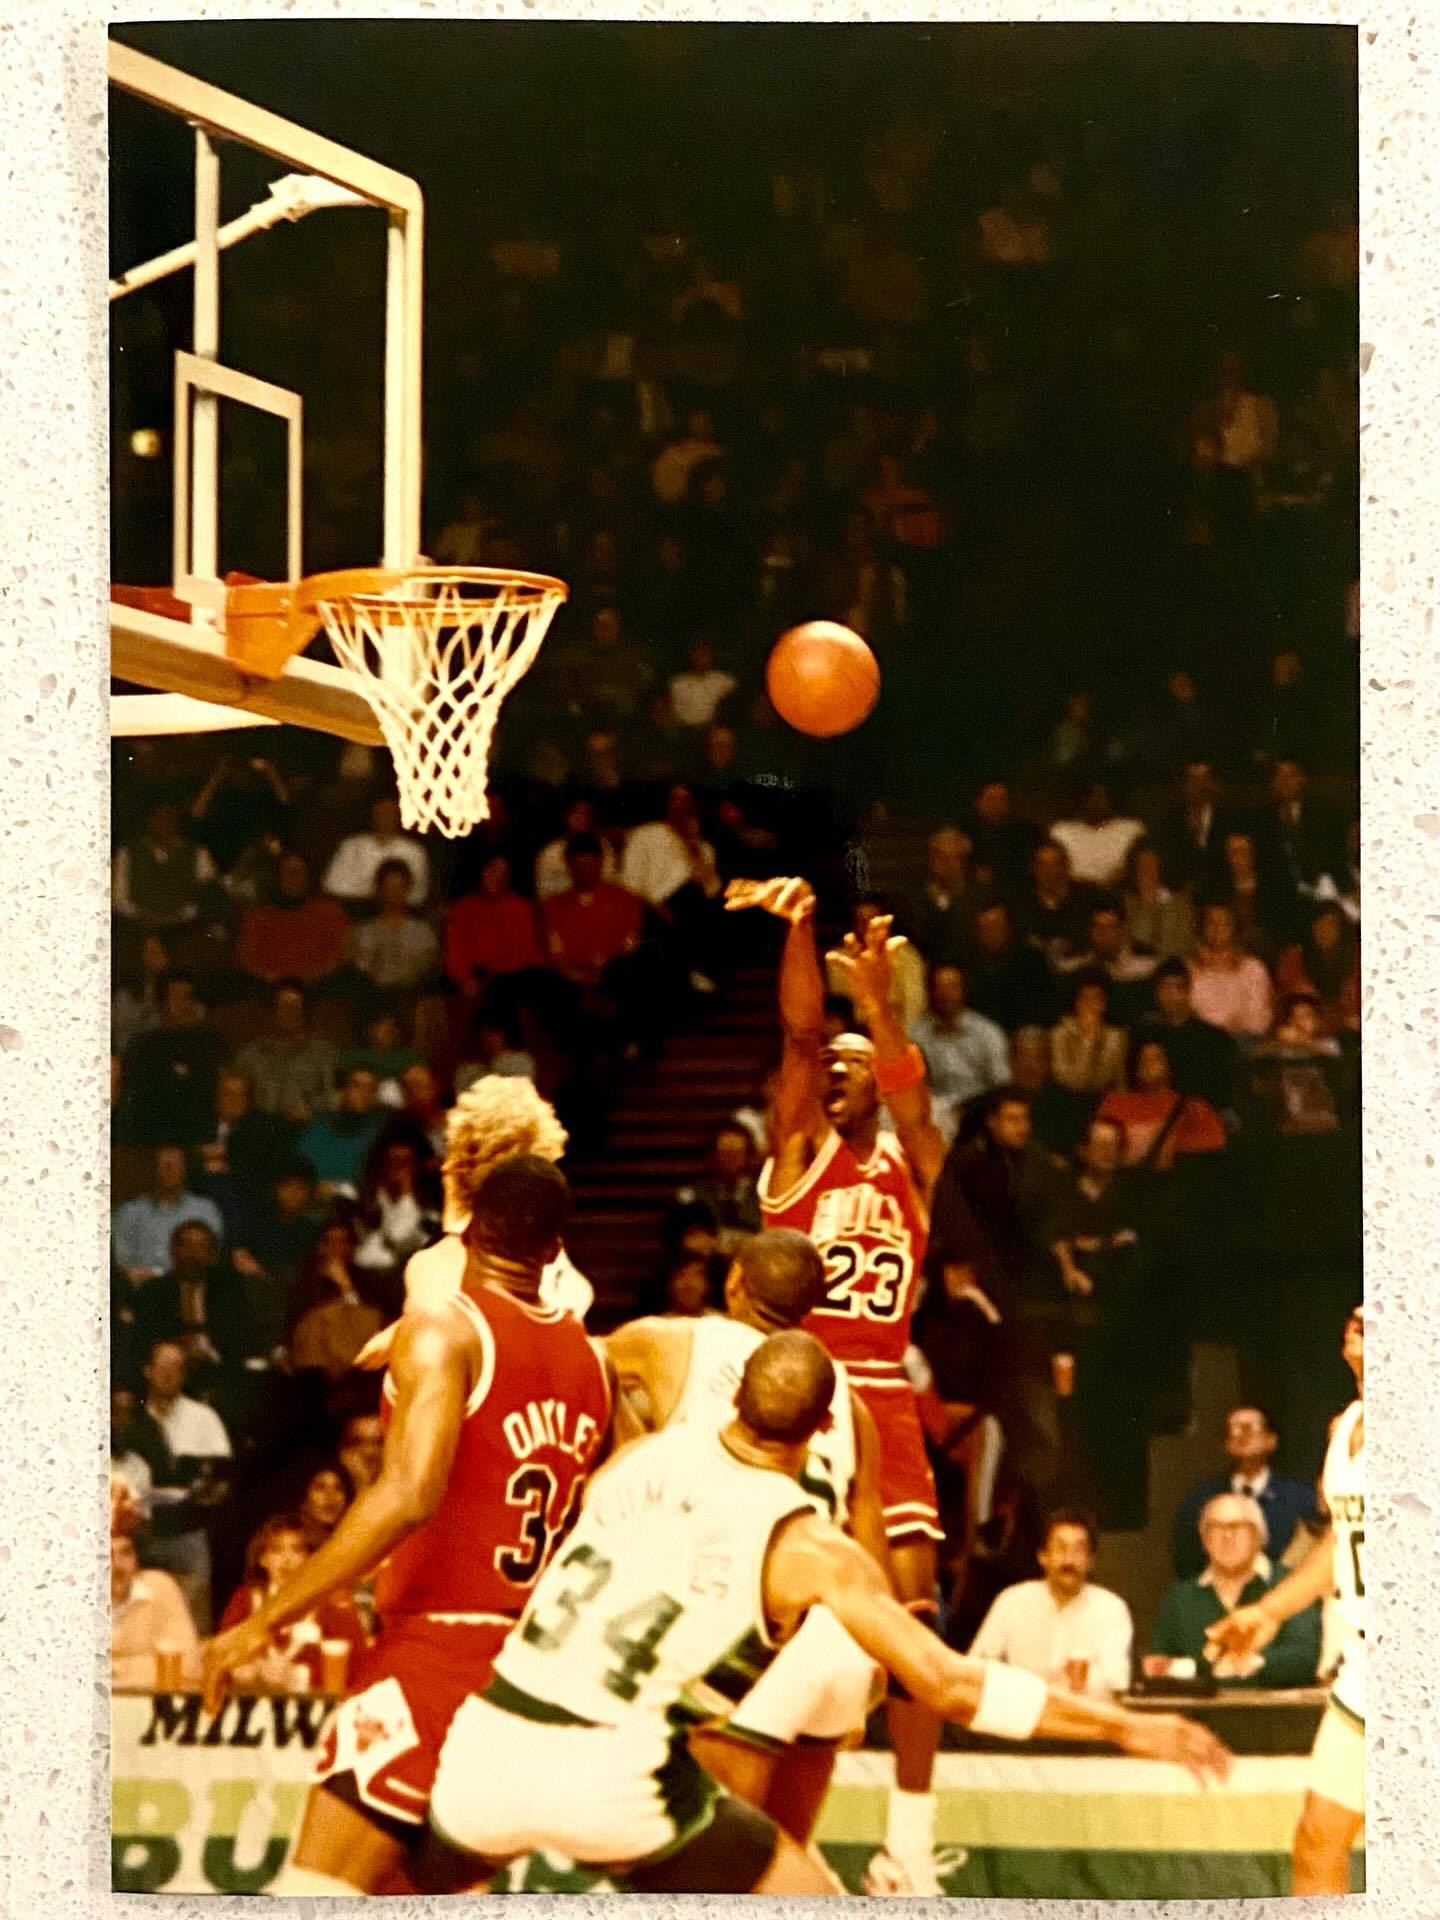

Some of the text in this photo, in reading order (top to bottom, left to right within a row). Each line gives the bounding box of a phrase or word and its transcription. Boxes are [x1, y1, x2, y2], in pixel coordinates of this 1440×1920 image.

[810, 1182, 911, 1248] BULL
[810, 1240, 914, 1322] 23
[520, 1543, 684, 1702] 34
